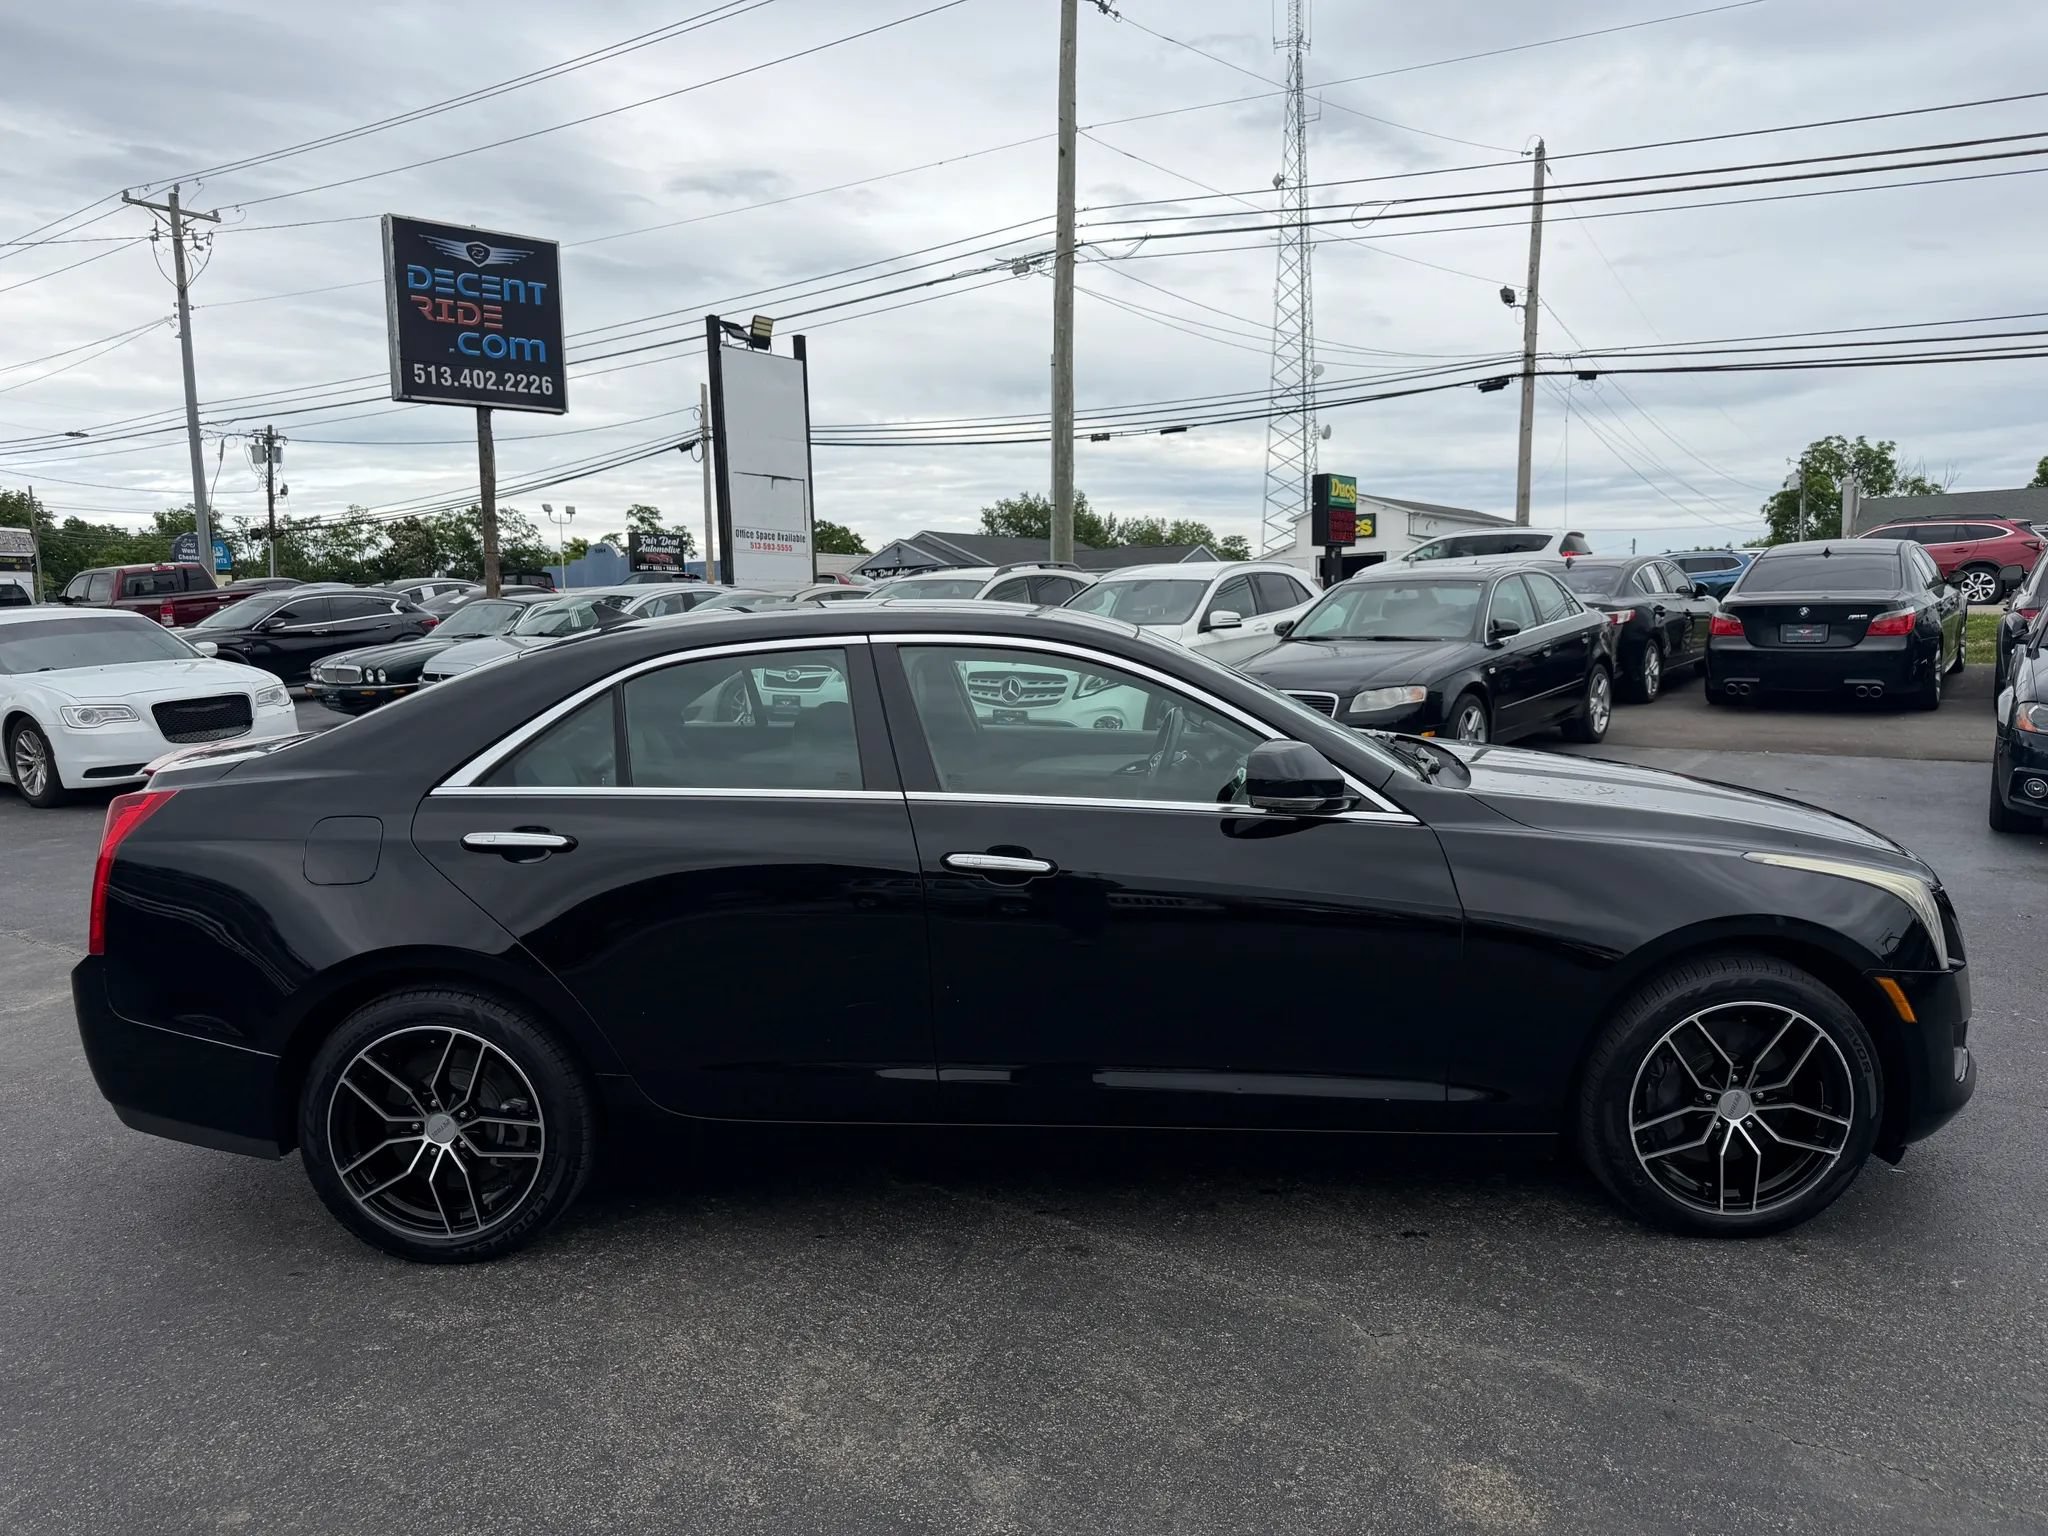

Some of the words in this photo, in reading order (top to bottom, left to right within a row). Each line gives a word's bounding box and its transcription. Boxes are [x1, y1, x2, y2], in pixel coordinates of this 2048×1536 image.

[410, 295, 504, 330] RIDE
[413, 363, 553, 396] 513.402.2226
[639, 534, 657, 545] Fair
[658, 535, 680, 546] Deal
[735, 528, 755, 540] Office
[755, 530, 776, 542] Space
[777, 532, 806, 544] Available
[636, 543, 681, 554] Automotive
